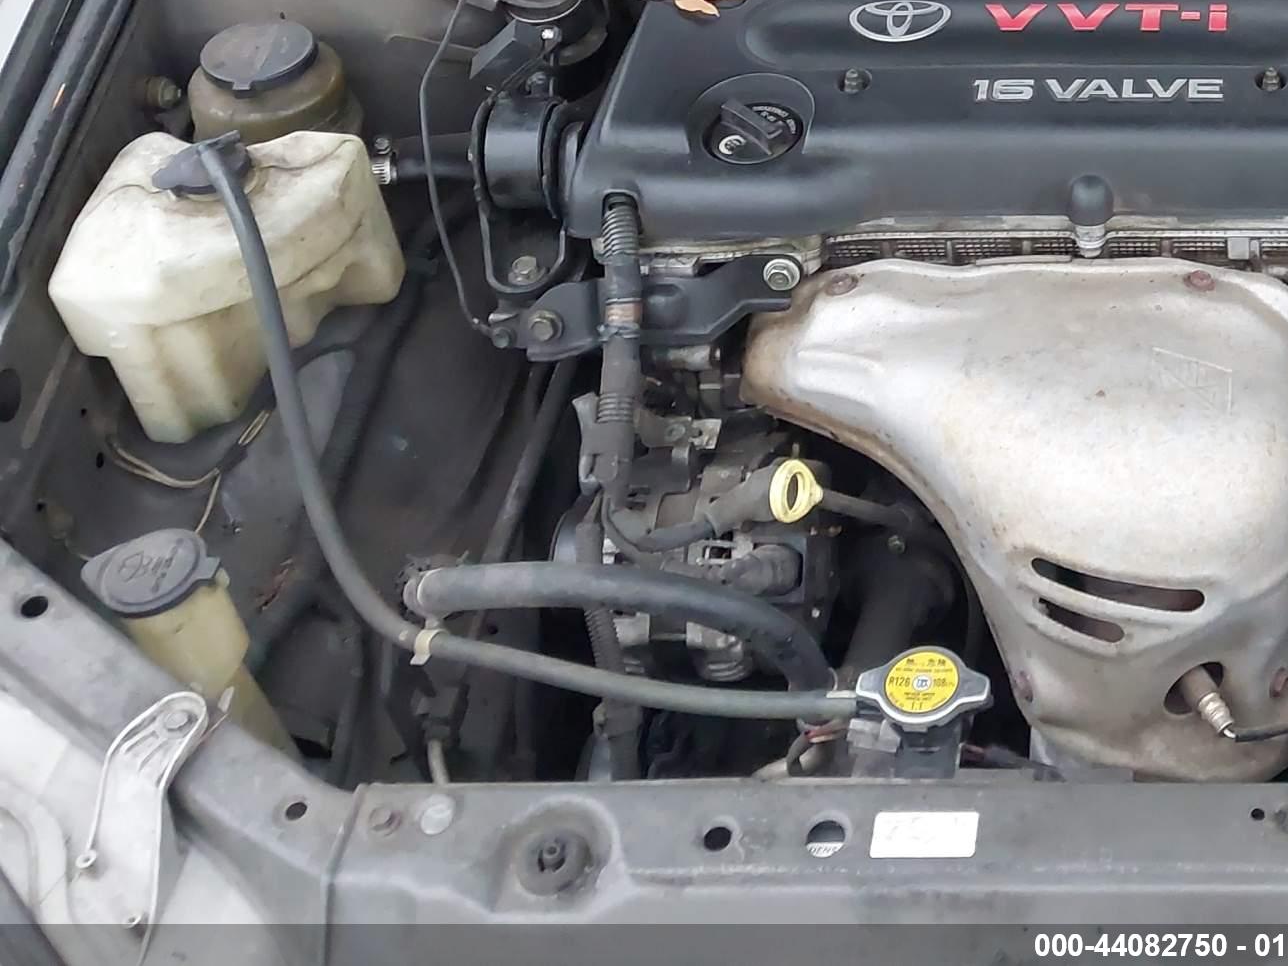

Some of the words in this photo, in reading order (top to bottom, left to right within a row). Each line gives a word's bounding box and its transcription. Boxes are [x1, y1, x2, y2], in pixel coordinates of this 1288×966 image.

[984, 2, 1229, 33] VVT-i
[971, 77, 1034, 101] 16
[1044, 77, 1225, 101] VALVE
